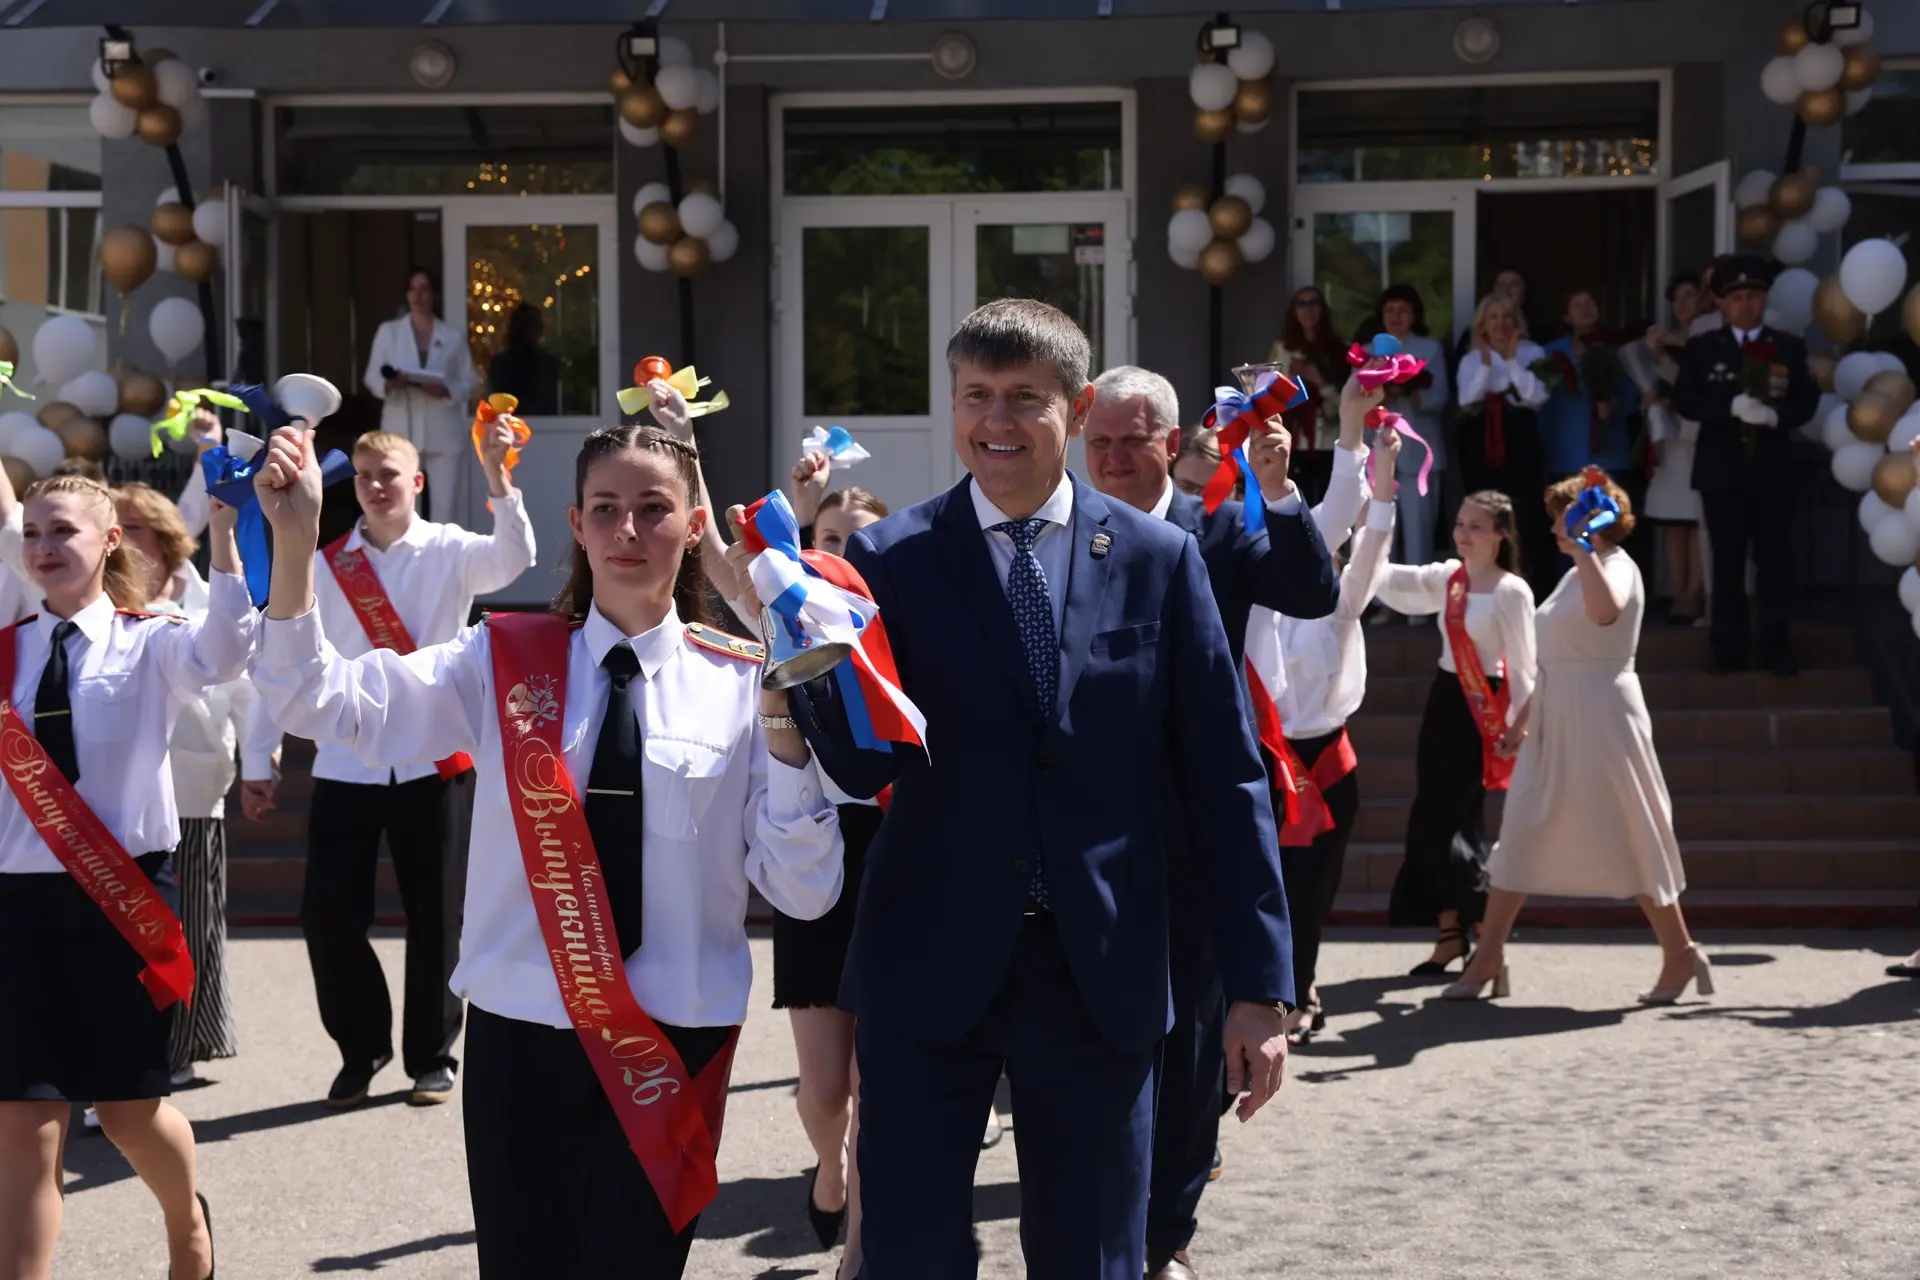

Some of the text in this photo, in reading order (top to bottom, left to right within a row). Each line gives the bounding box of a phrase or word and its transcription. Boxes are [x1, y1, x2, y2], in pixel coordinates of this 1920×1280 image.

[0, 728, 127, 897] Выпускница
[514, 737, 613, 1020] Выпускница
[572, 841, 615, 982] г. Калининград
